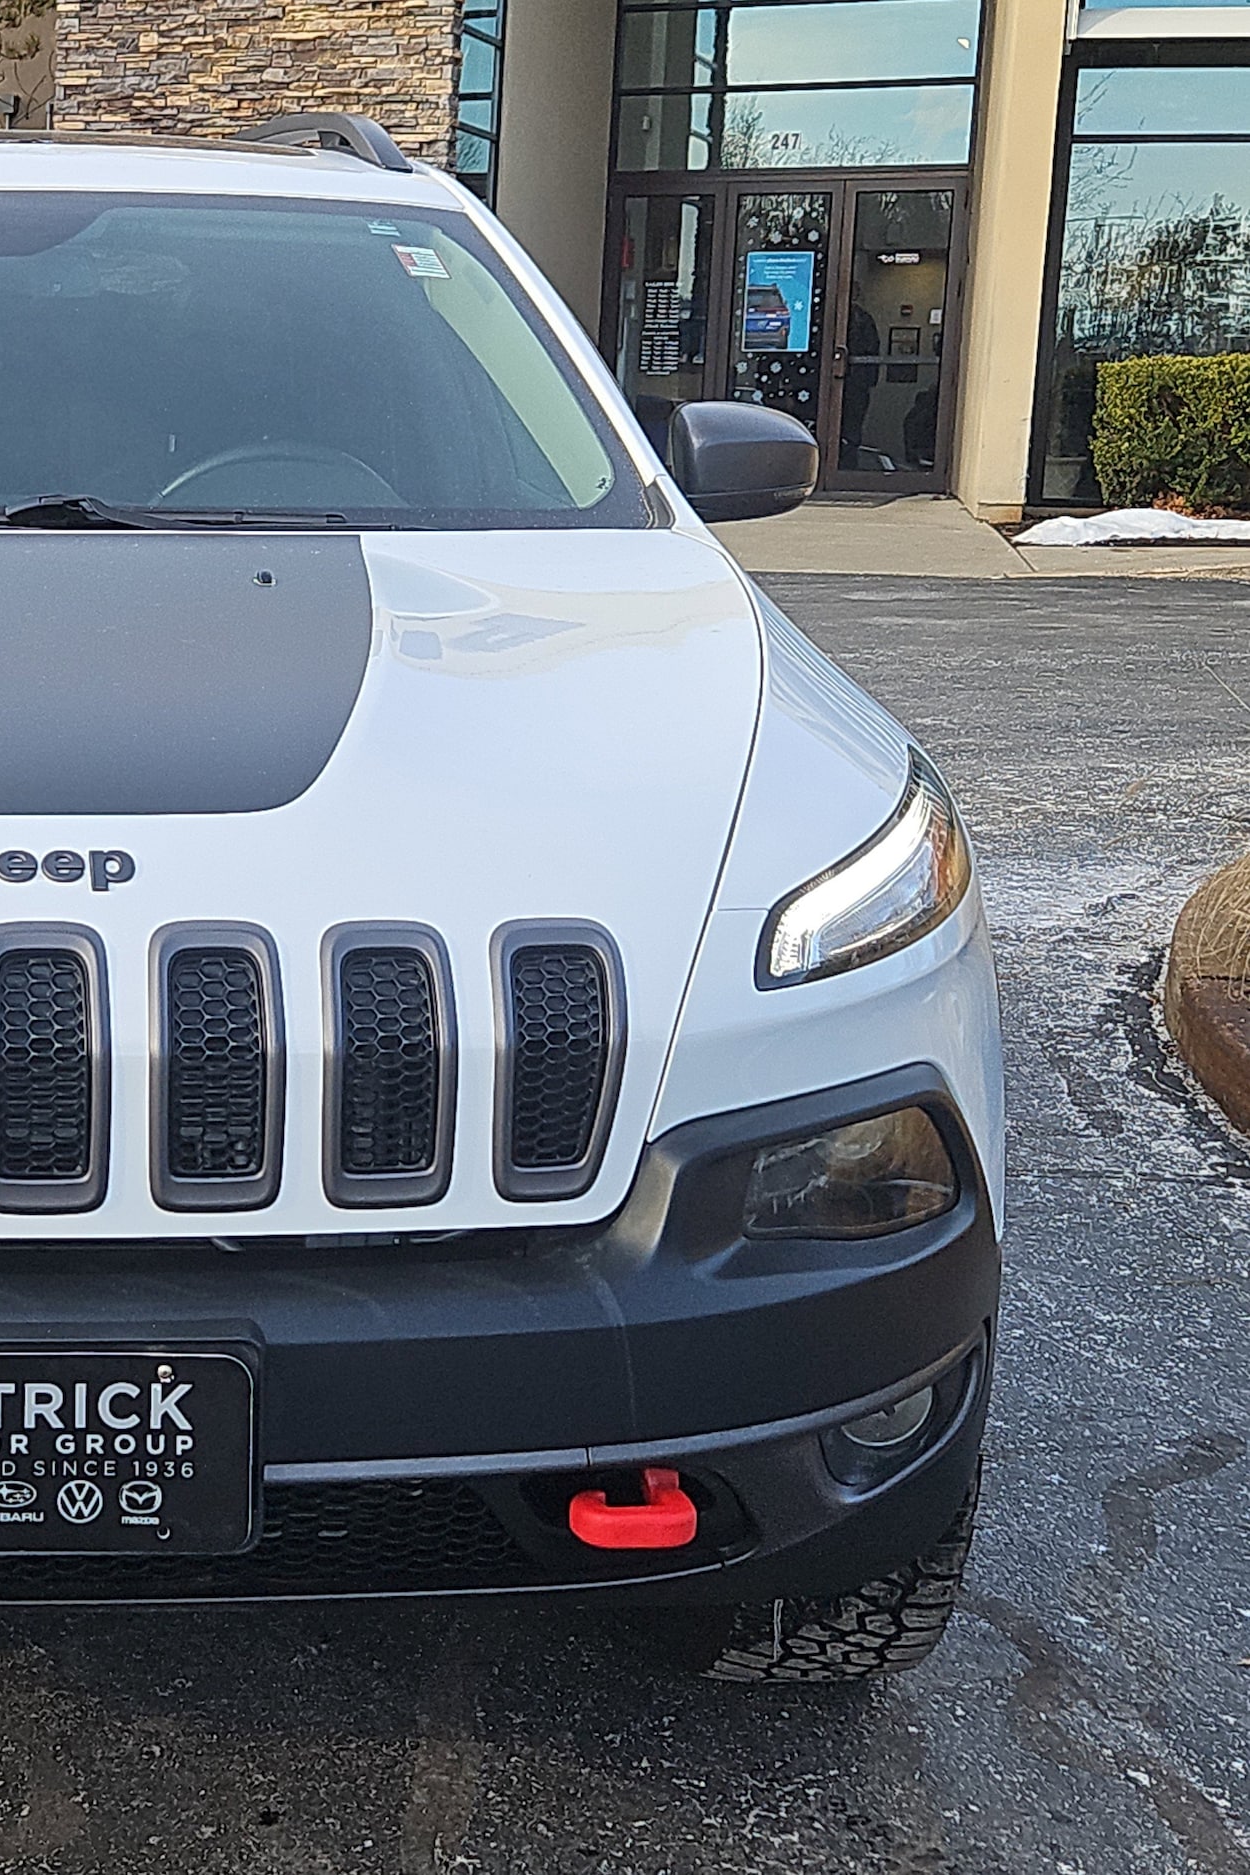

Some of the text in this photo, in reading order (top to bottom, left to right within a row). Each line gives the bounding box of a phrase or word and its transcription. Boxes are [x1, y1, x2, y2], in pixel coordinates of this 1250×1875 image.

[771, 133, 800, 150] 247
[55, 1433, 194, 1456] GROUP
[32, 1460, 116, 1477] SINCE
[133, 1460, 194, 1478] 1936
